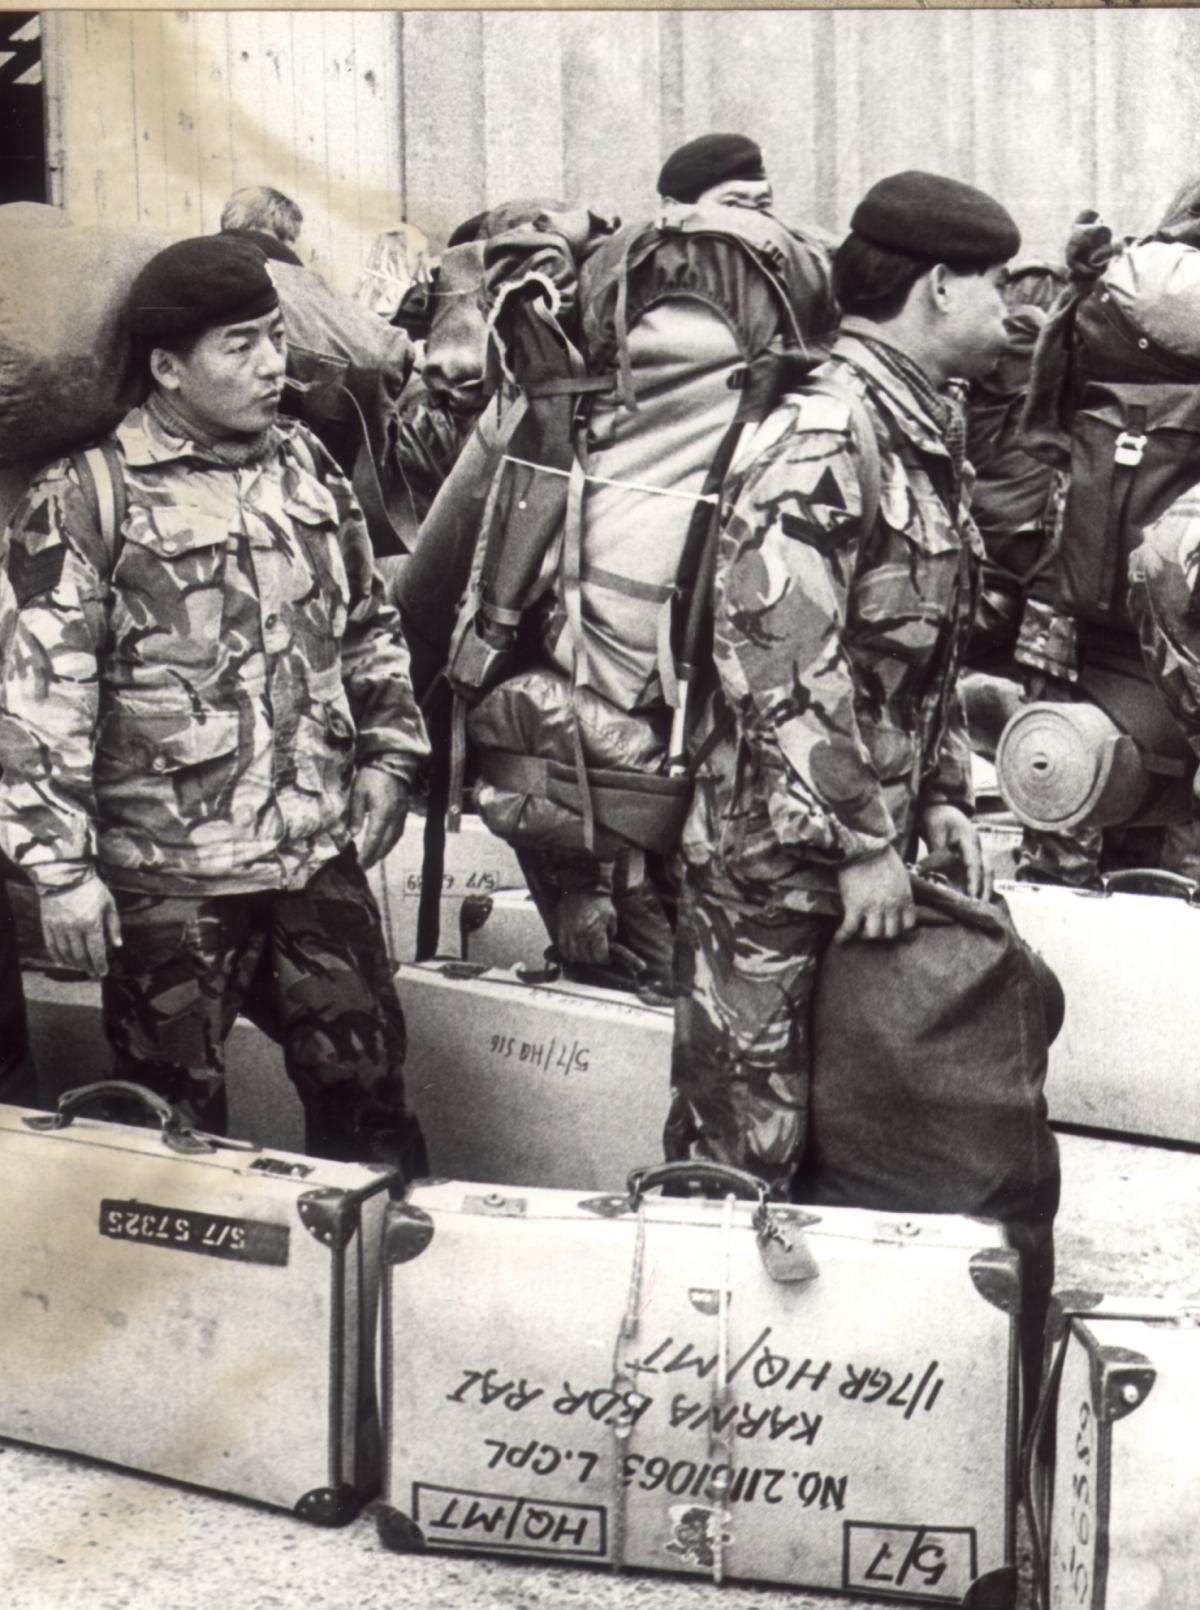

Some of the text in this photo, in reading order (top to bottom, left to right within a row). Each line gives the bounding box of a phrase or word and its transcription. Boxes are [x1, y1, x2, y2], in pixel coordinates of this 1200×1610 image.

[108, 1211, 246, 1249] 5/7 57325
[446, 1369, 545, 1412] RAI
[624, 1327, 944, 1421] 1/7GR HQ/MT
[670, 1393, 823, 1447] KARNA
[429, 1496, 589, 1546] HQ/MT
[864, 1524, 947, 1587] 5/7
